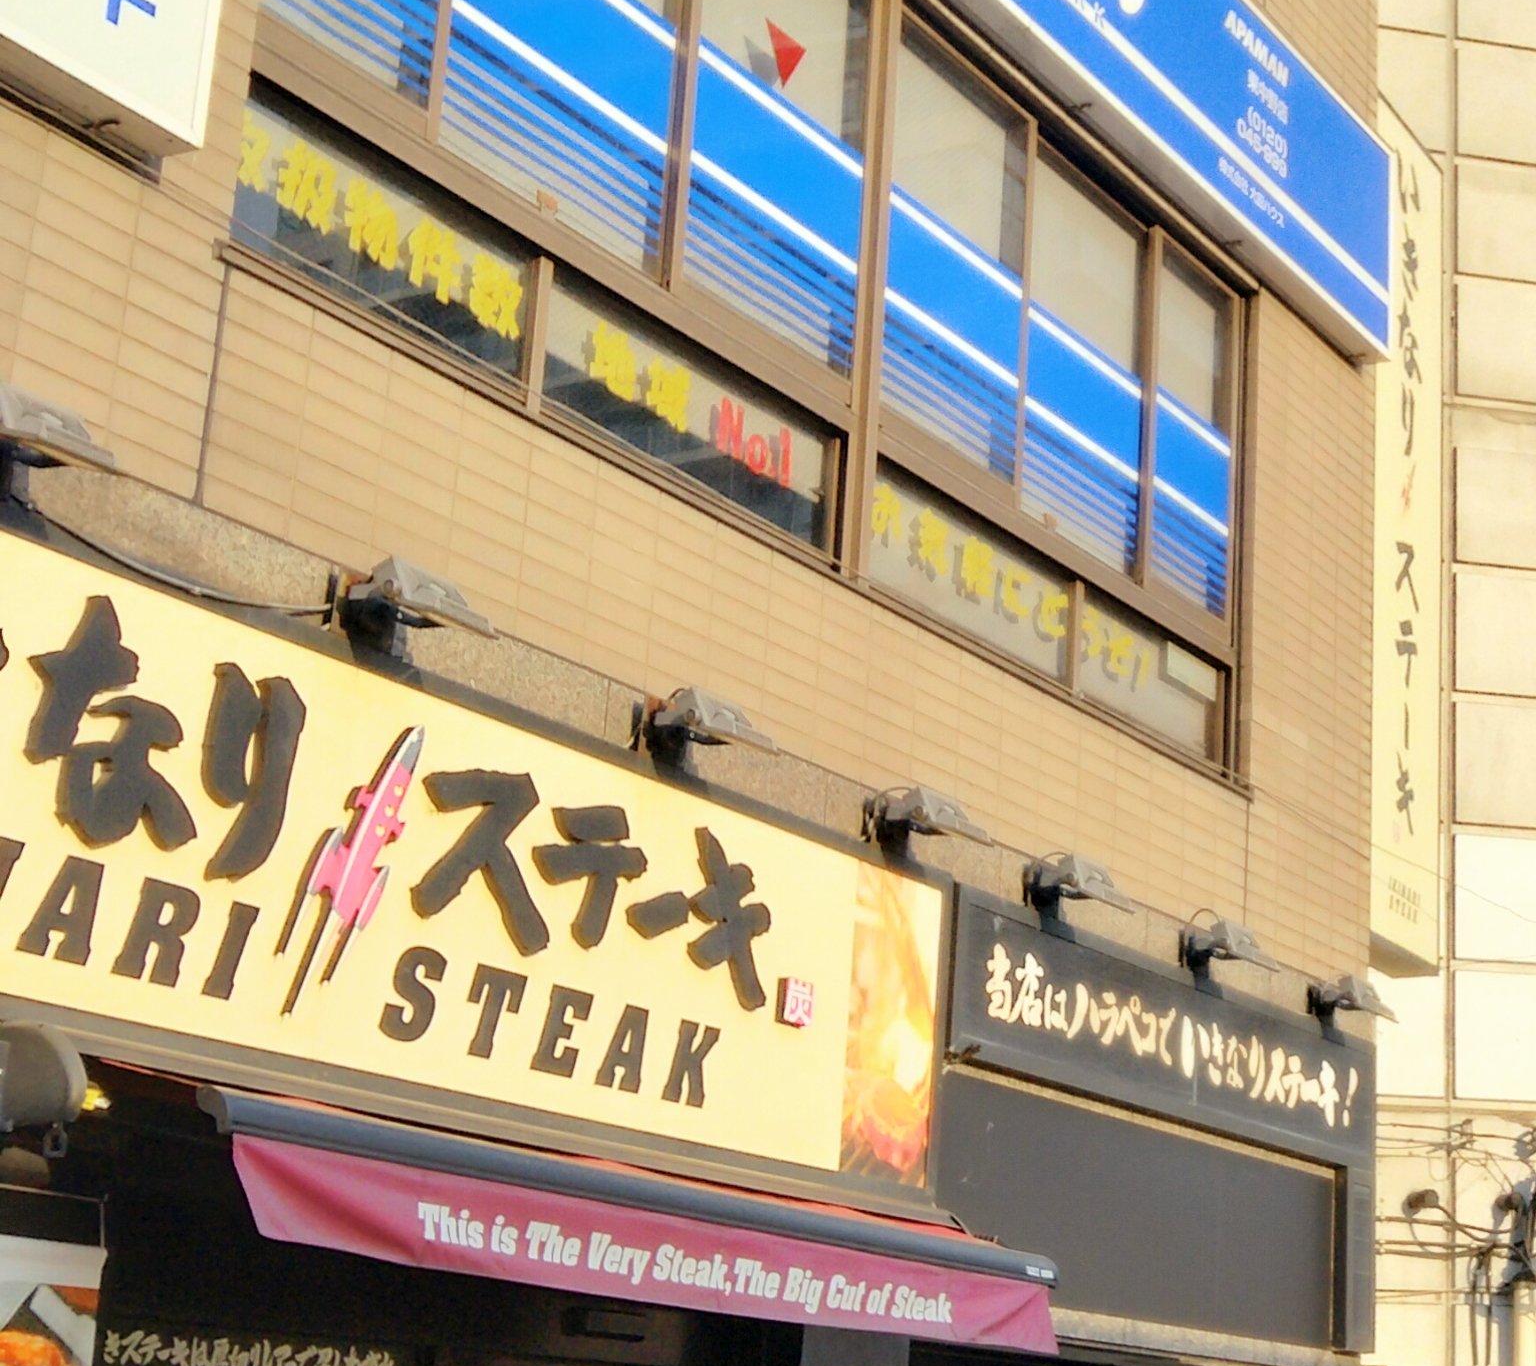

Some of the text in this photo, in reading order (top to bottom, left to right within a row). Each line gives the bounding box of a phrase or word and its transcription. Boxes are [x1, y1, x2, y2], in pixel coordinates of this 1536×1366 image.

[1223, 8, 1290, 88] APAMAN
[0, 595, 306, 883] なり
[1394, 540, 1419, 836] ステーキ
[409, 768, 772, 1012] ステーキ
[377, 945, 721, 1109] STEAK
[417, 1201, 485, 1250] This
[490, 1215, 518, 1257] is
[525, 1220, 579, 1267] The
[587, 1231, 652, 1285] Very
[783, 1266, 825, 1314] Big
[826, 1274, 867, 1313] Cut
[866, 1282, 892, 1316] of
[891, 1285, 953, 1325] Steak
